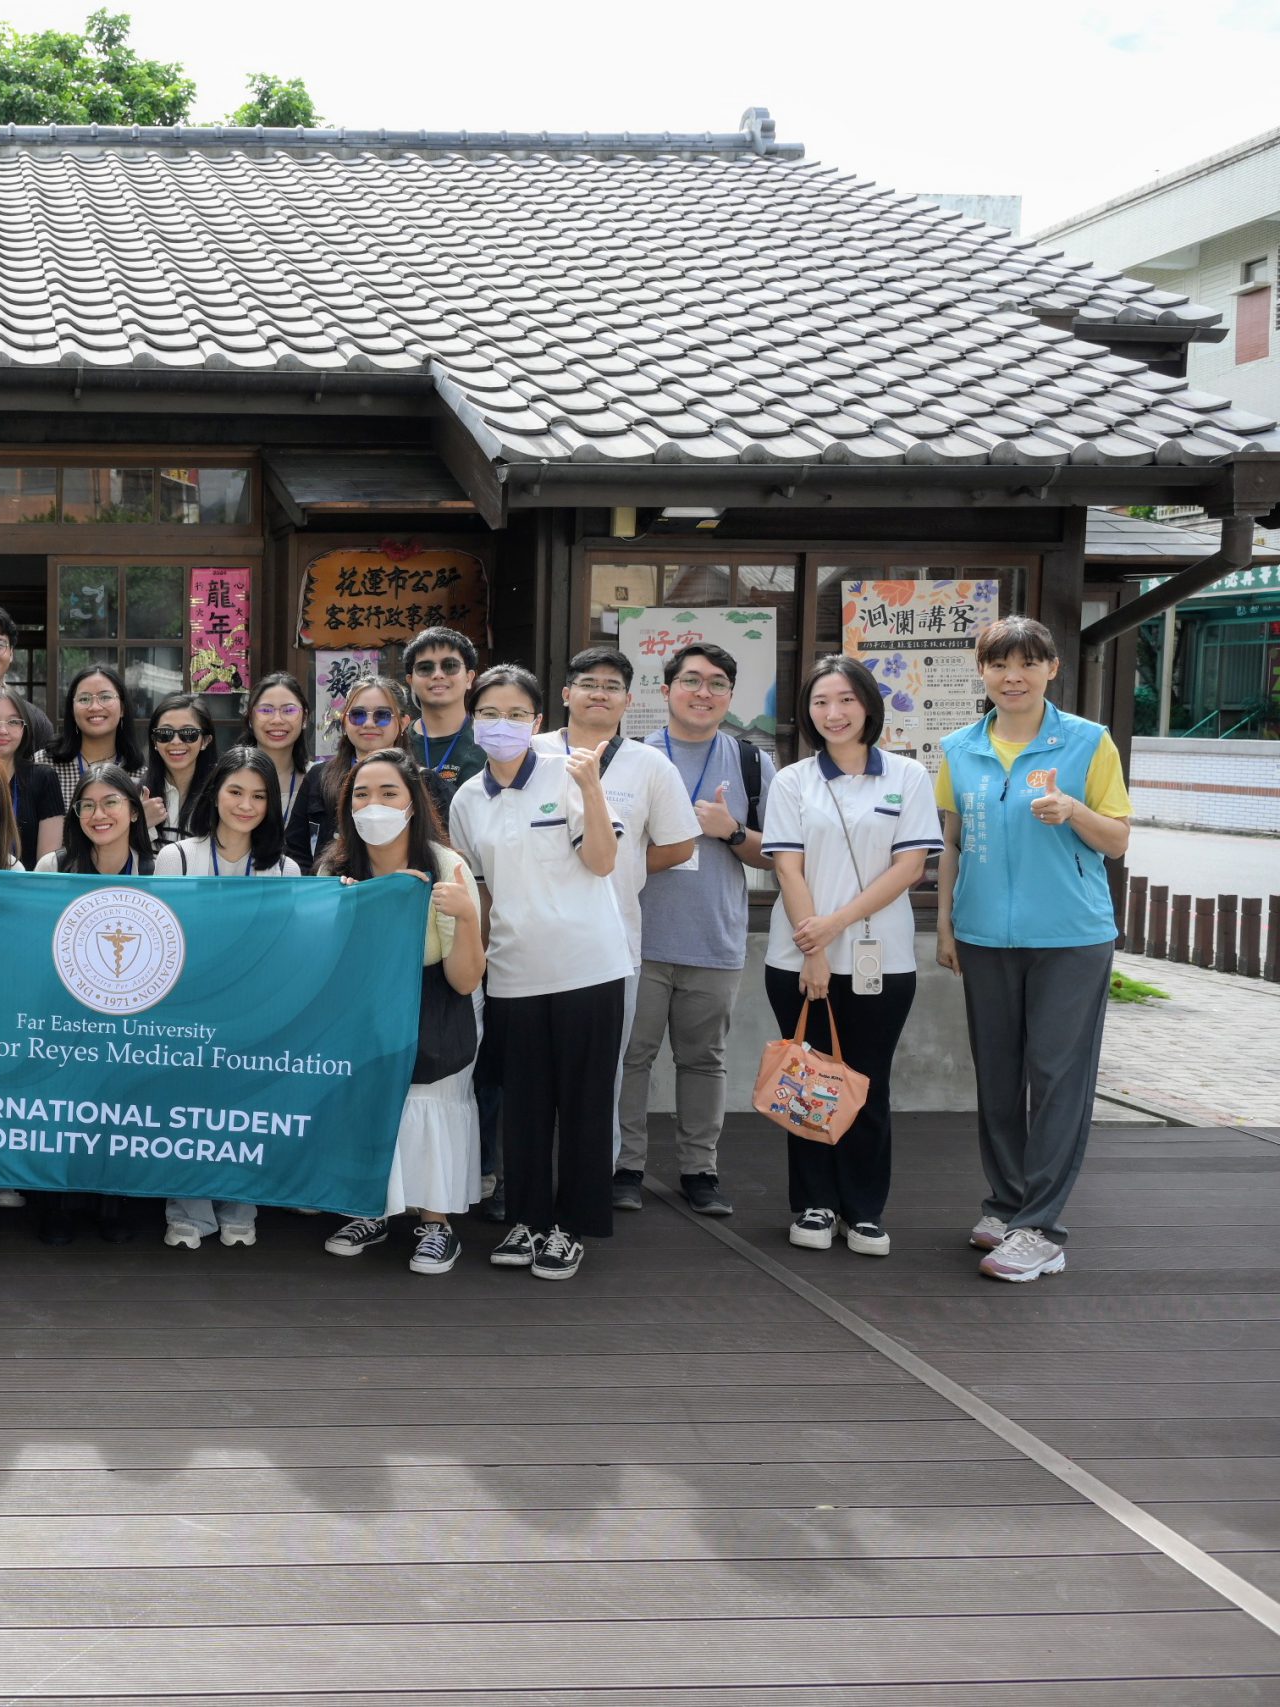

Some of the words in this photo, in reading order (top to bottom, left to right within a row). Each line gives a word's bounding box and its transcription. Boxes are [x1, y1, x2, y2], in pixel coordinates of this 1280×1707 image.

[335, 565, 463, 600] 花蓮市公所
[205, 579, 236, 648] 龍年
[324, 603, 470, 632] 客家行政事務所
[859, 603, 976, 635] 洄瀾講客
[74, 895, 109, 919] REYES
[112, 893, 165, 923] MEDICAL
[86, 908, 121, 930] EASTERN
[125, 909, 161, 952] UNIVERSITY
[61, 918, 78, 978] NICANOR
[138, 923, 177, 1002] FOUNDATION
[76, 977, 94, 998] DR.
[103, 995, 130, 1007] 1971
[17, 1013, 47, 1030] Far
[51, 1015, 117, 1034] Eastern
[124, 1019, 216, 1045] University
[27, 1037, 99, 1068] Reyes
[106, 1042, 203, 1067] Medical
[210, 1047, 353, 1076] Foundation
[168, 1106, 312, 1137] STUDENT
[109, 1134, 264, 1165] PROGRAM
